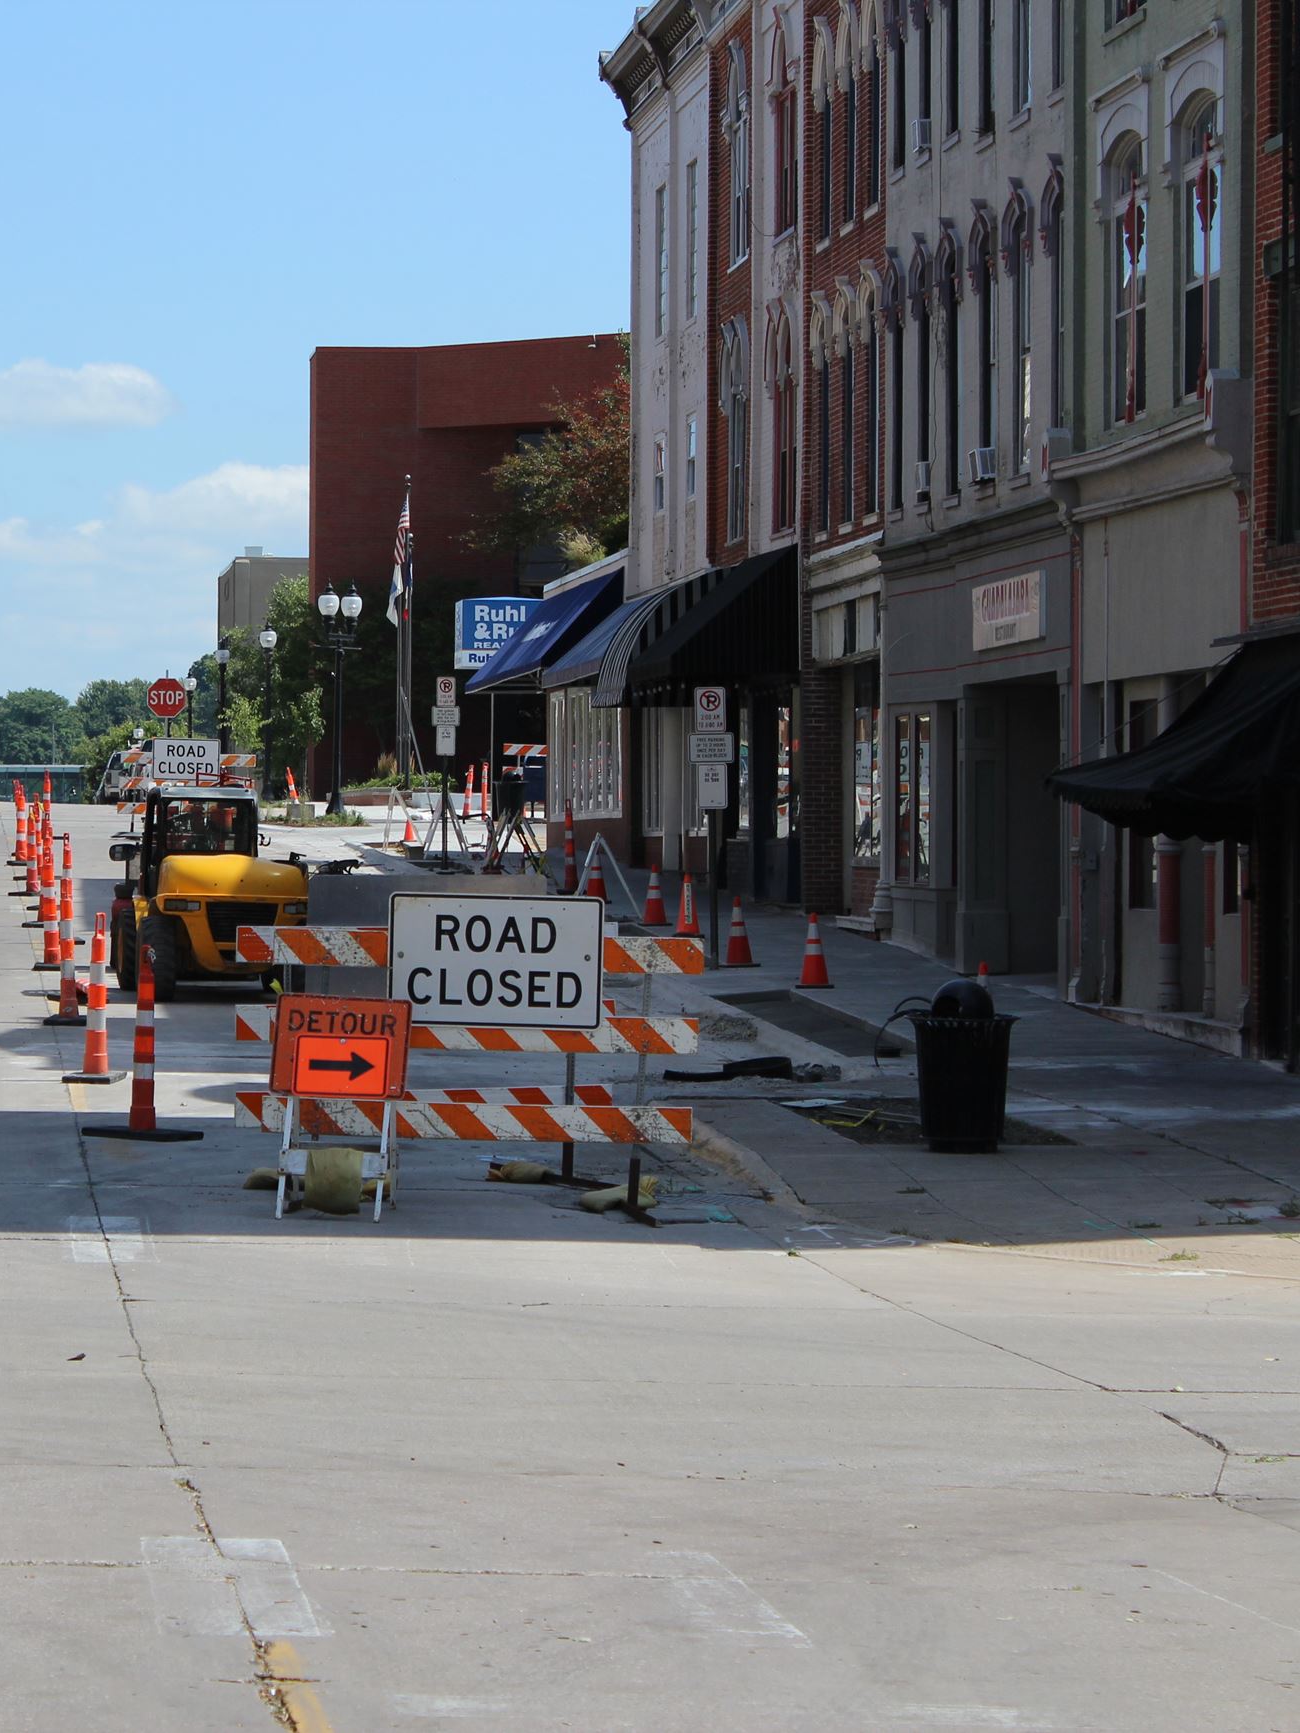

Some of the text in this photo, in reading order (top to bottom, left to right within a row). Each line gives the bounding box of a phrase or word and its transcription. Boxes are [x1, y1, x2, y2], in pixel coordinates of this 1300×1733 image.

[474, 605, 526, 622] Ruhl
[469, 653, 492, 663] Ruh
[150, 690, 184, 706] STOP
[167, 744, 206, 758] ROAD
[158, 761, 214, 775] CLOSED
[435, 914, 557, 954] ROAD
[407, 967, 582, 1009] CLOSED
[288, 1009, 397, 1037] DETOUR
